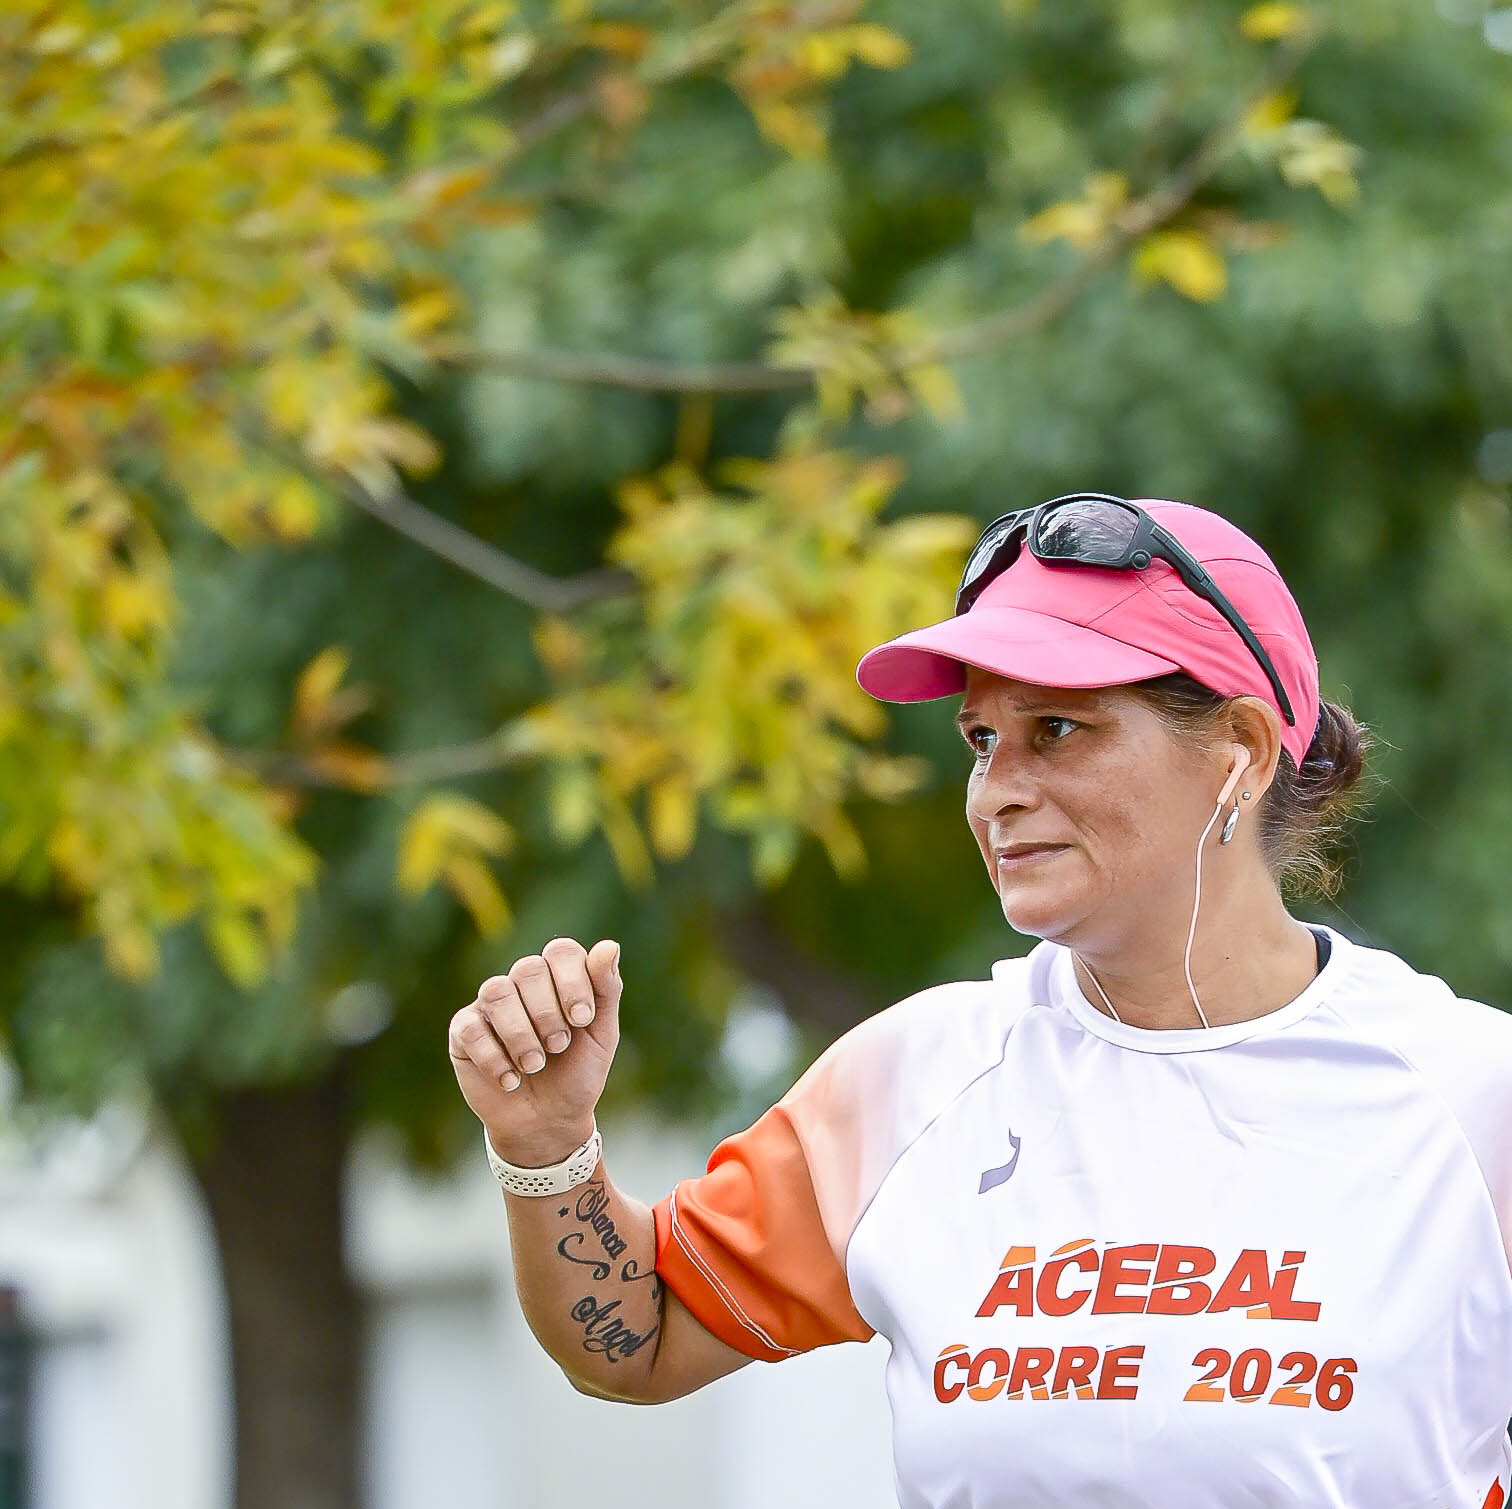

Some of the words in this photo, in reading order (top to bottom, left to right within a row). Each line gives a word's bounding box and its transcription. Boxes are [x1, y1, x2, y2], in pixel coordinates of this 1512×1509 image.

[974, 1238, 1322, 1322] ACEBAL
[933, 1344, 1146, 1404] CORRE
[1183, 1347, 1359, 1412] 2026
